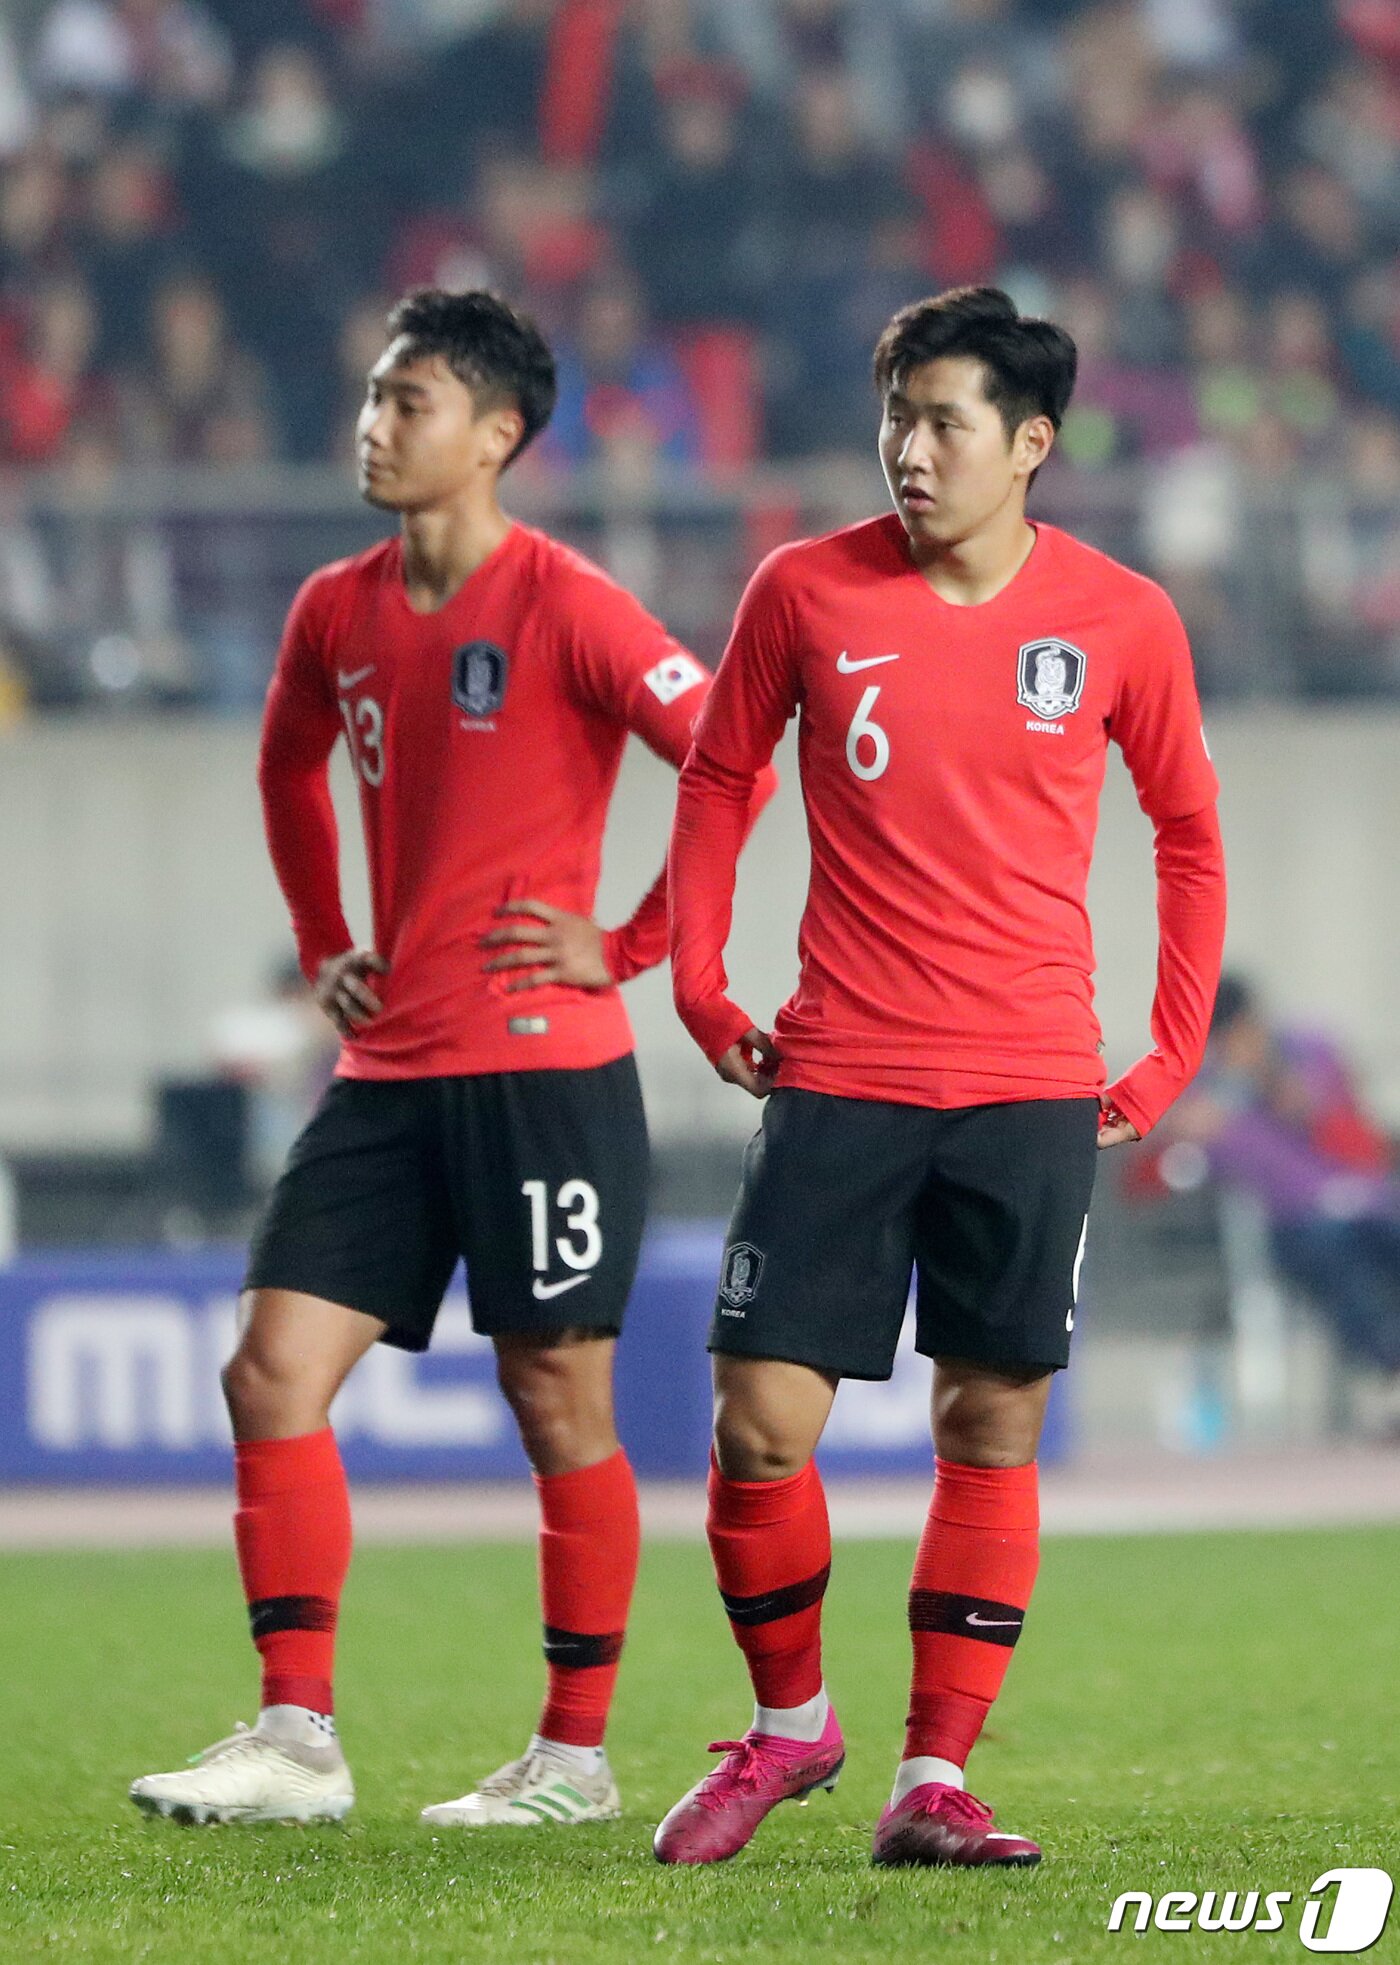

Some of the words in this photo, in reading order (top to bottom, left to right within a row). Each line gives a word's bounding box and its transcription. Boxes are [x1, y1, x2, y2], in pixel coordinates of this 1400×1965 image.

[338, 697, 386, 788] 13
[846, 685, 890, 782] 6
[1025, 720, 1065, 736] KOREA
[521, 1179, 603, 1271] 13
